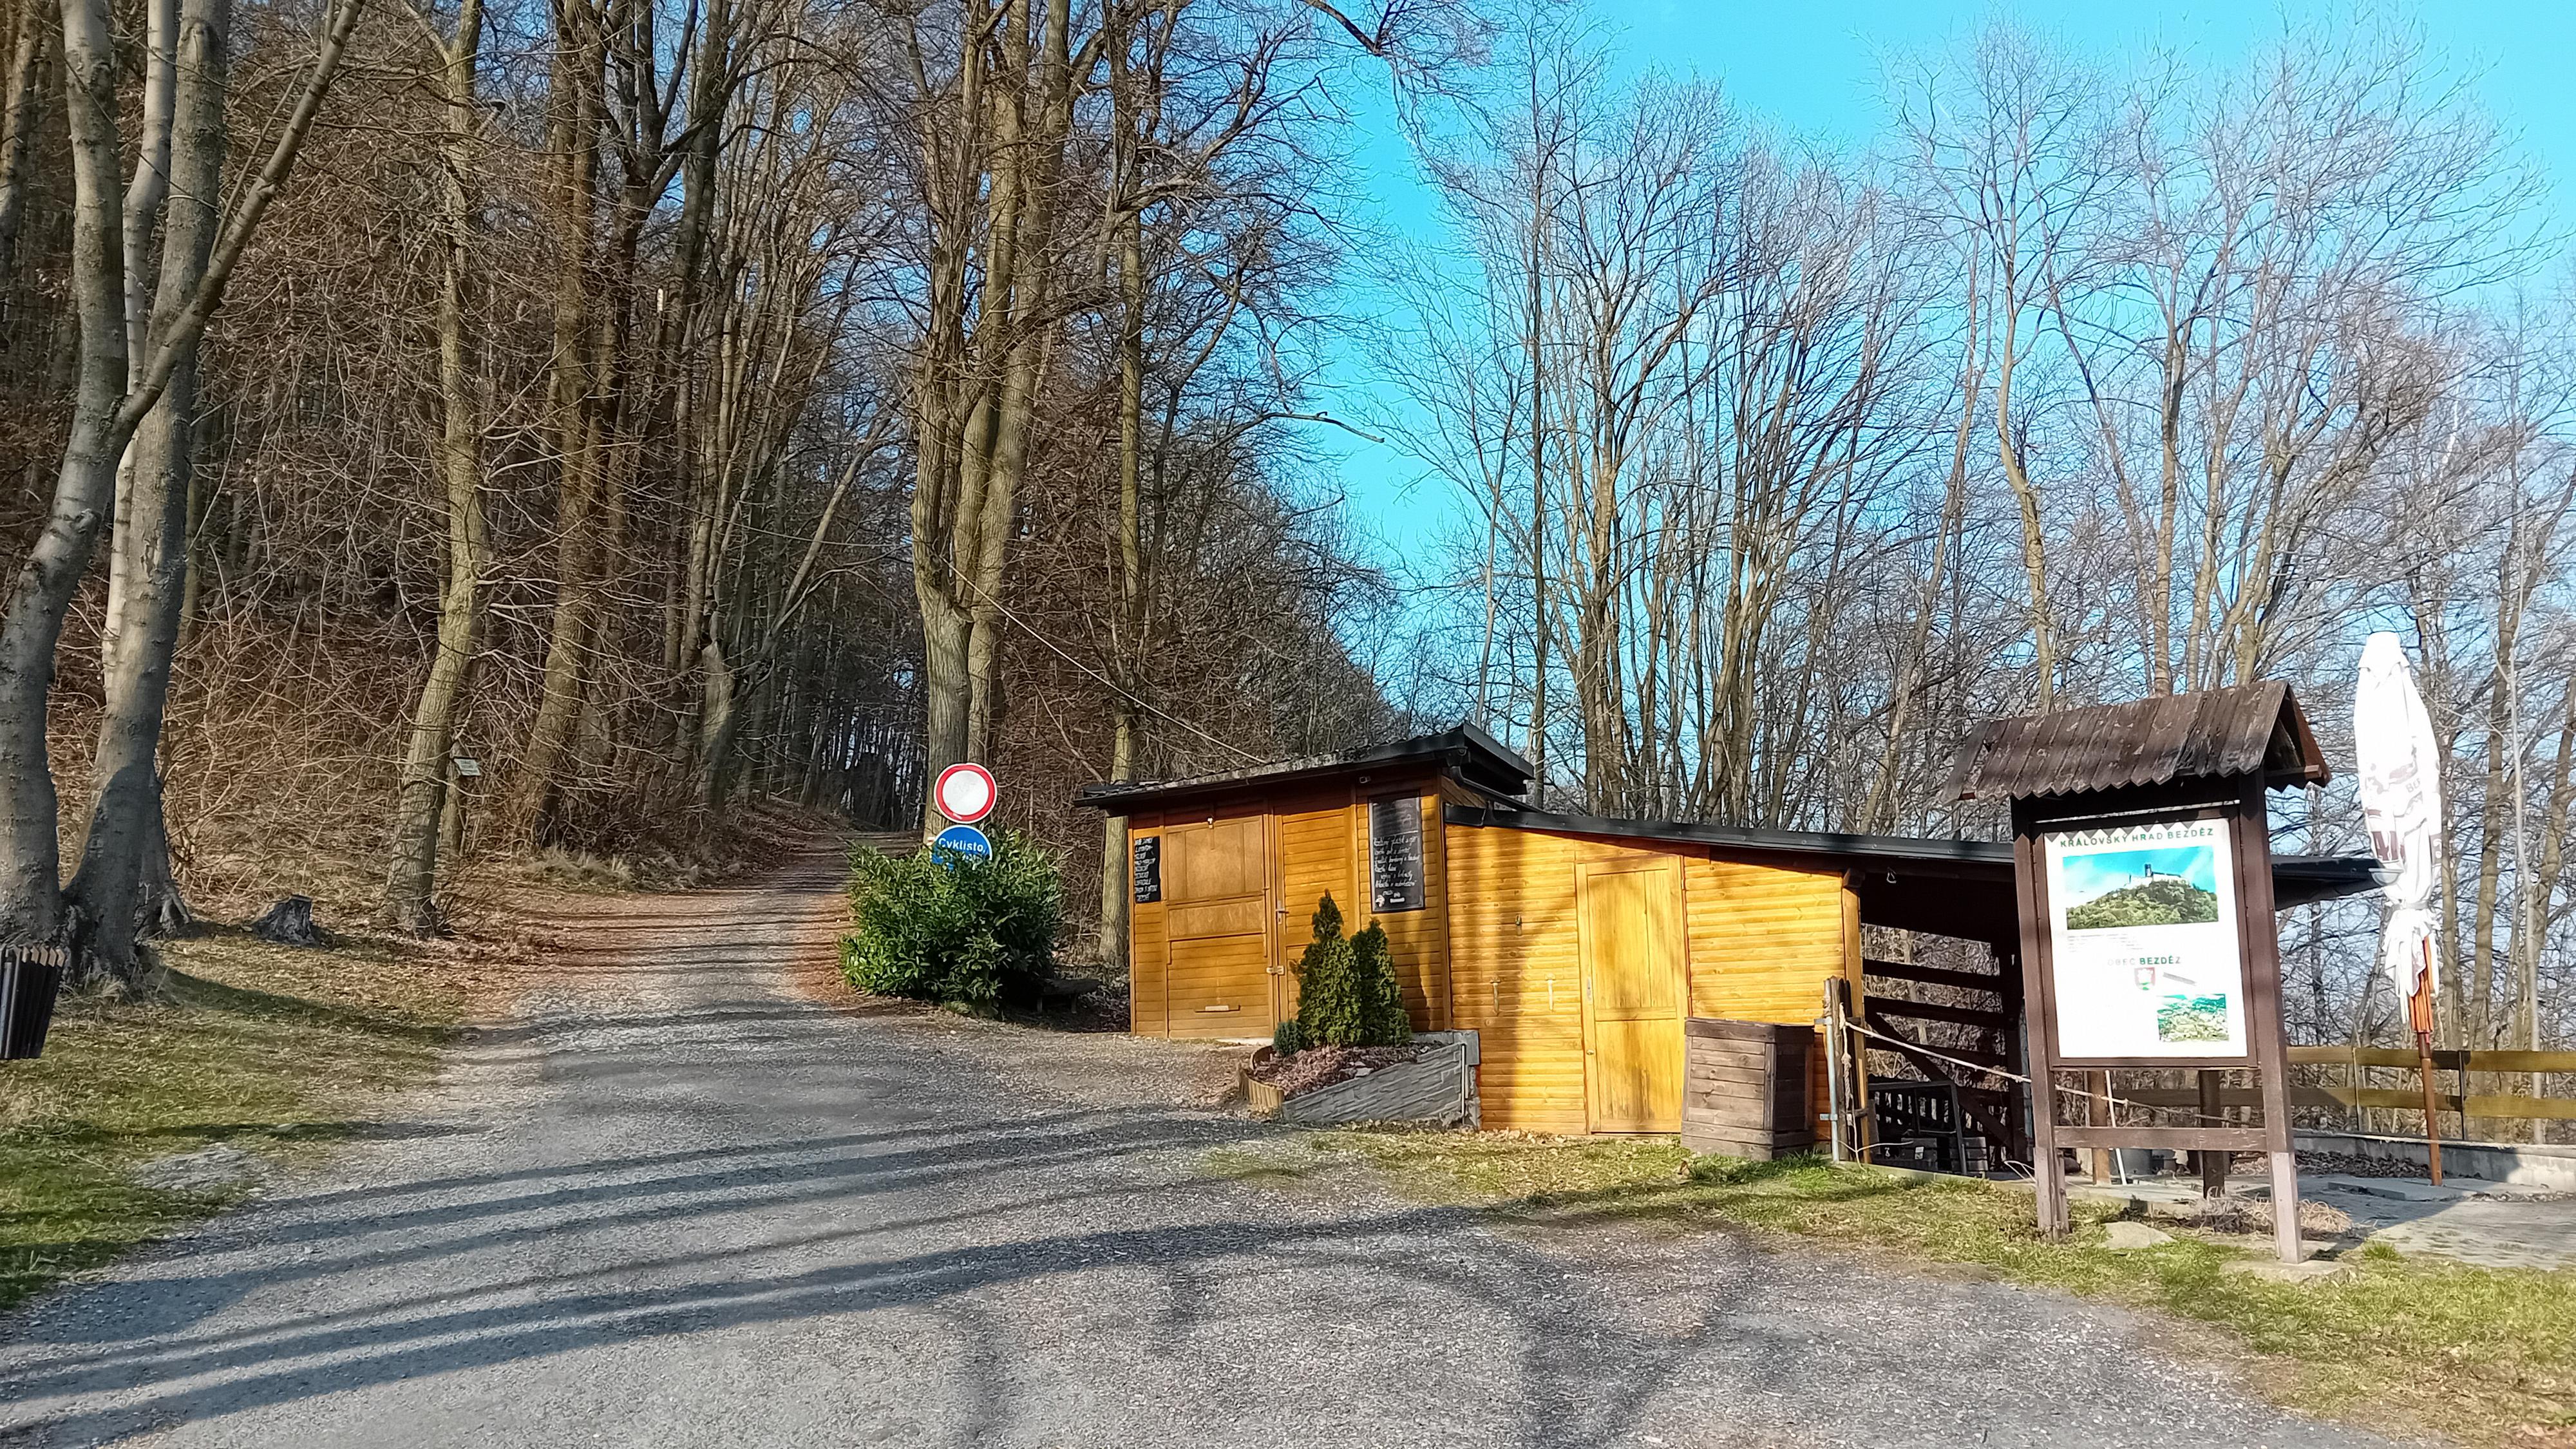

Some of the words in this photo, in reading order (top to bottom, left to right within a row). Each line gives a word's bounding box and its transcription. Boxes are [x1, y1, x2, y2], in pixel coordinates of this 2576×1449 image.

[2060, 833, 2128, 848] KRÁLOVSKÝ
[2132, 832, 2163, 842] HRAD
[2167, 828, 2213, 839] BEZDĚZ
[2107, 958, 2136, 966] OBEC
[2139, 955, 2181, 965] BEZDĚZ
